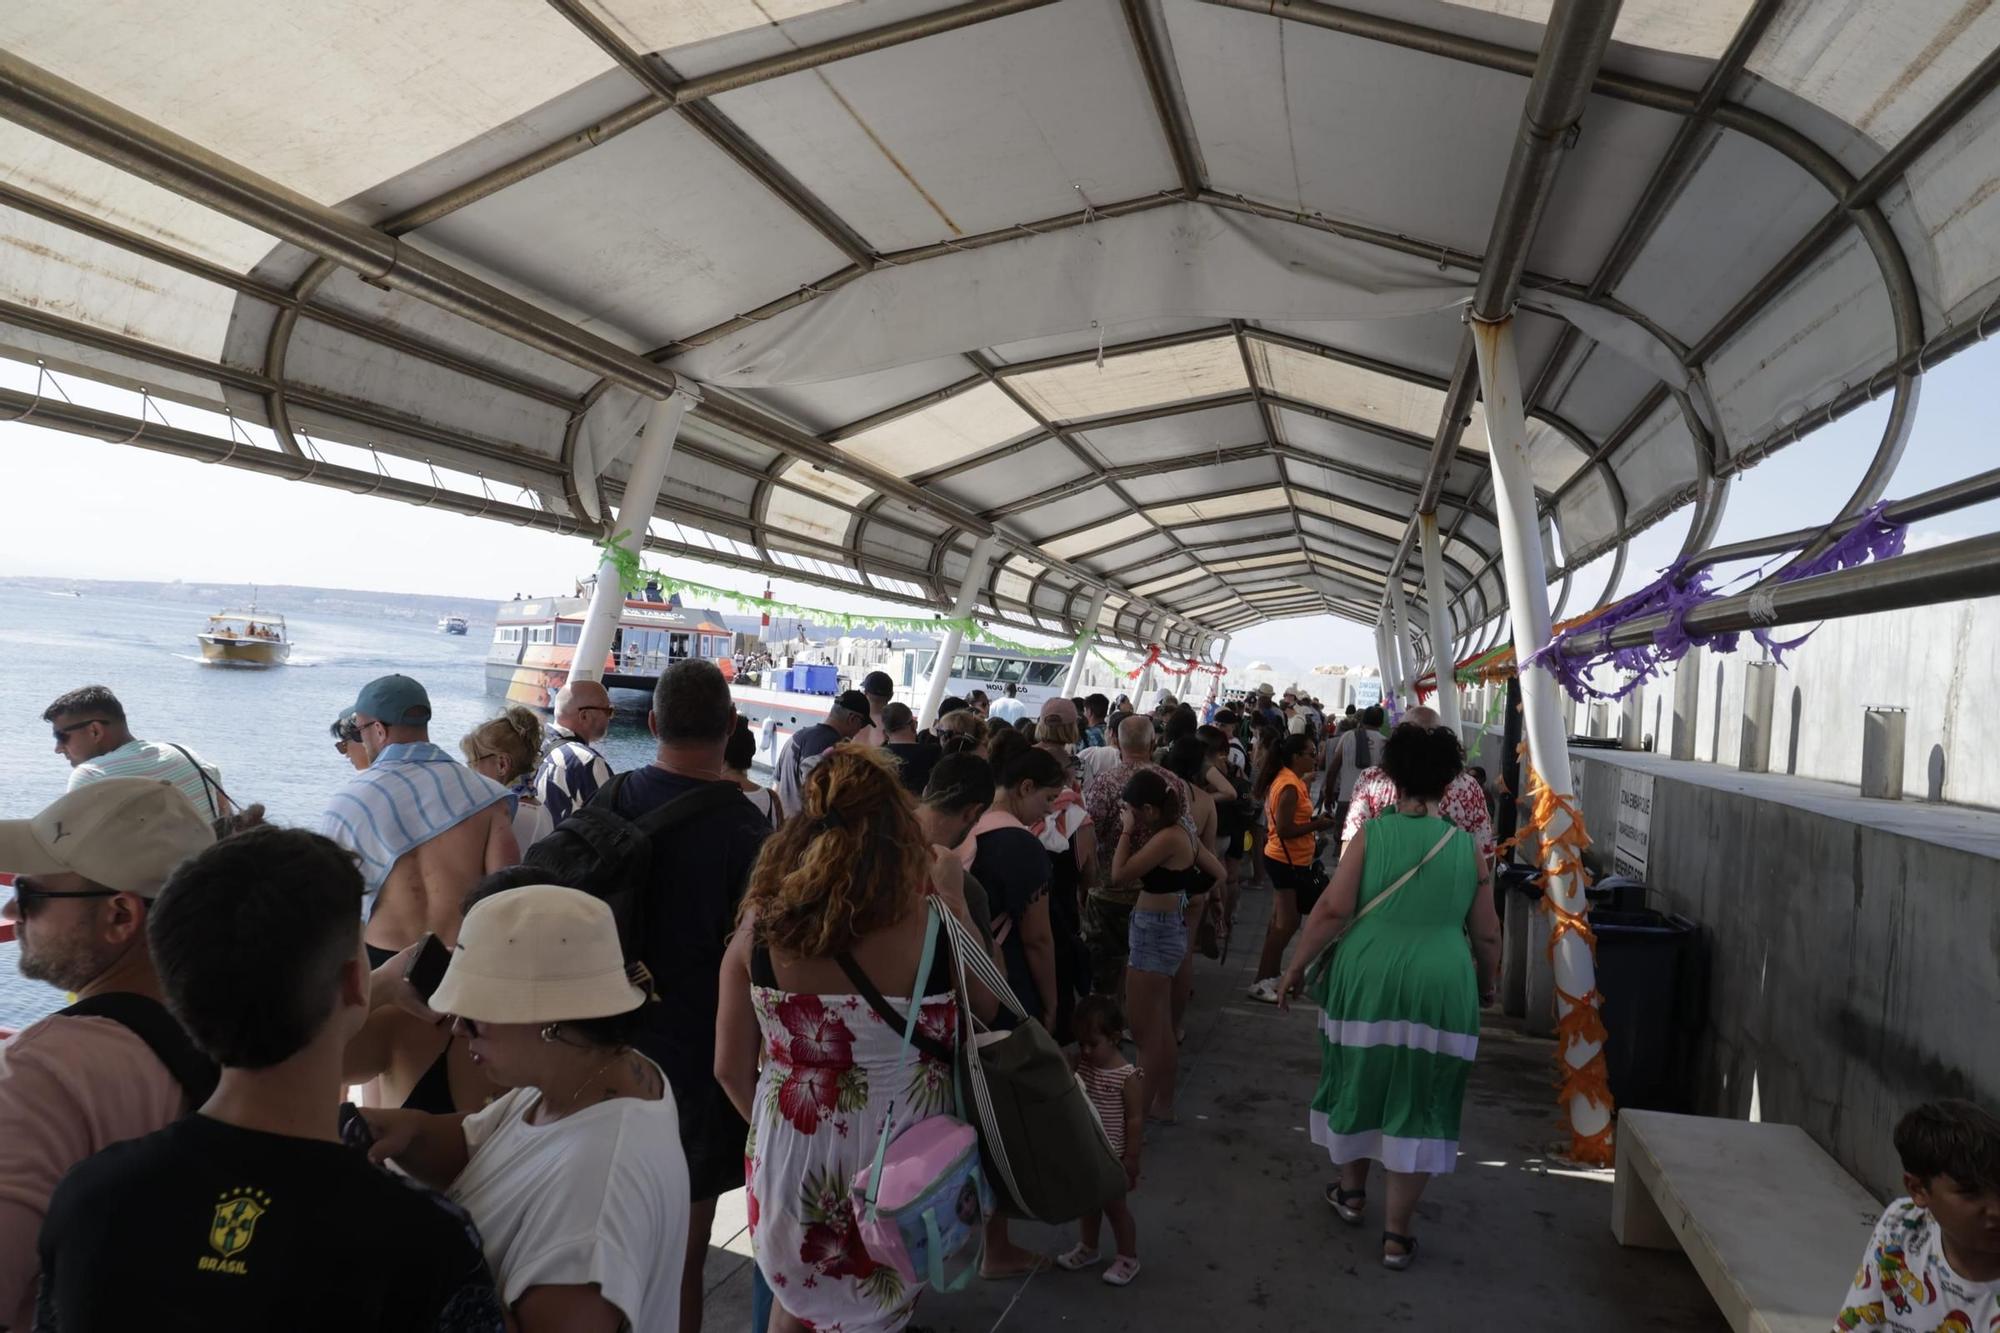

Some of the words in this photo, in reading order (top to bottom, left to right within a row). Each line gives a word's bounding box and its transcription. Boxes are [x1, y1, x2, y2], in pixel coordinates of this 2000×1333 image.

[642, 610, 687, 619] TABARCA
[986, 683, 1002, 691] NOU
[1630, 792, 1650, 815] EMBARQUE
[198, 1256, 247, 1274] BRASIL
